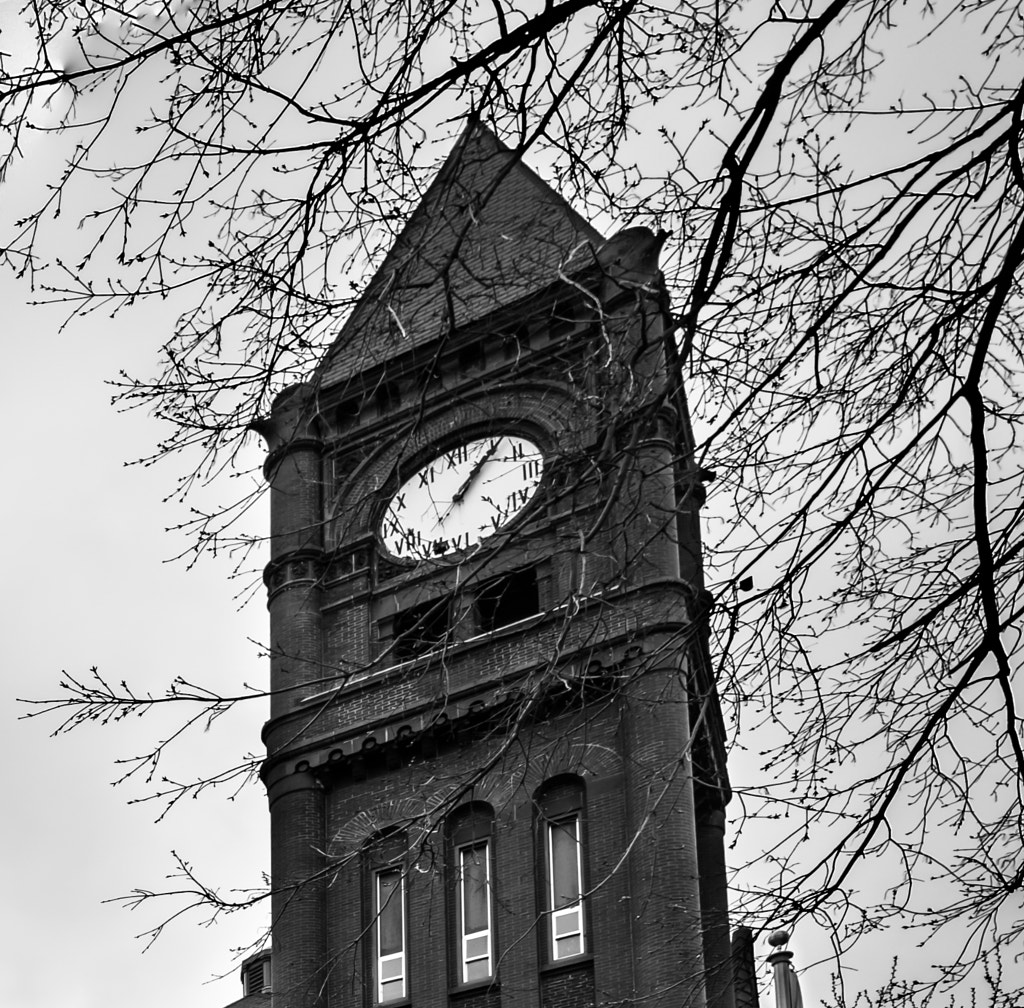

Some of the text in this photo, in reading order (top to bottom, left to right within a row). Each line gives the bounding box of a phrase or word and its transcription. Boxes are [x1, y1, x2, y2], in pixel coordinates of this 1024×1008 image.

[418, 467, 434, 488] XI
[522, 460, 538, 481] III
[396, 493, 406, 511] X
